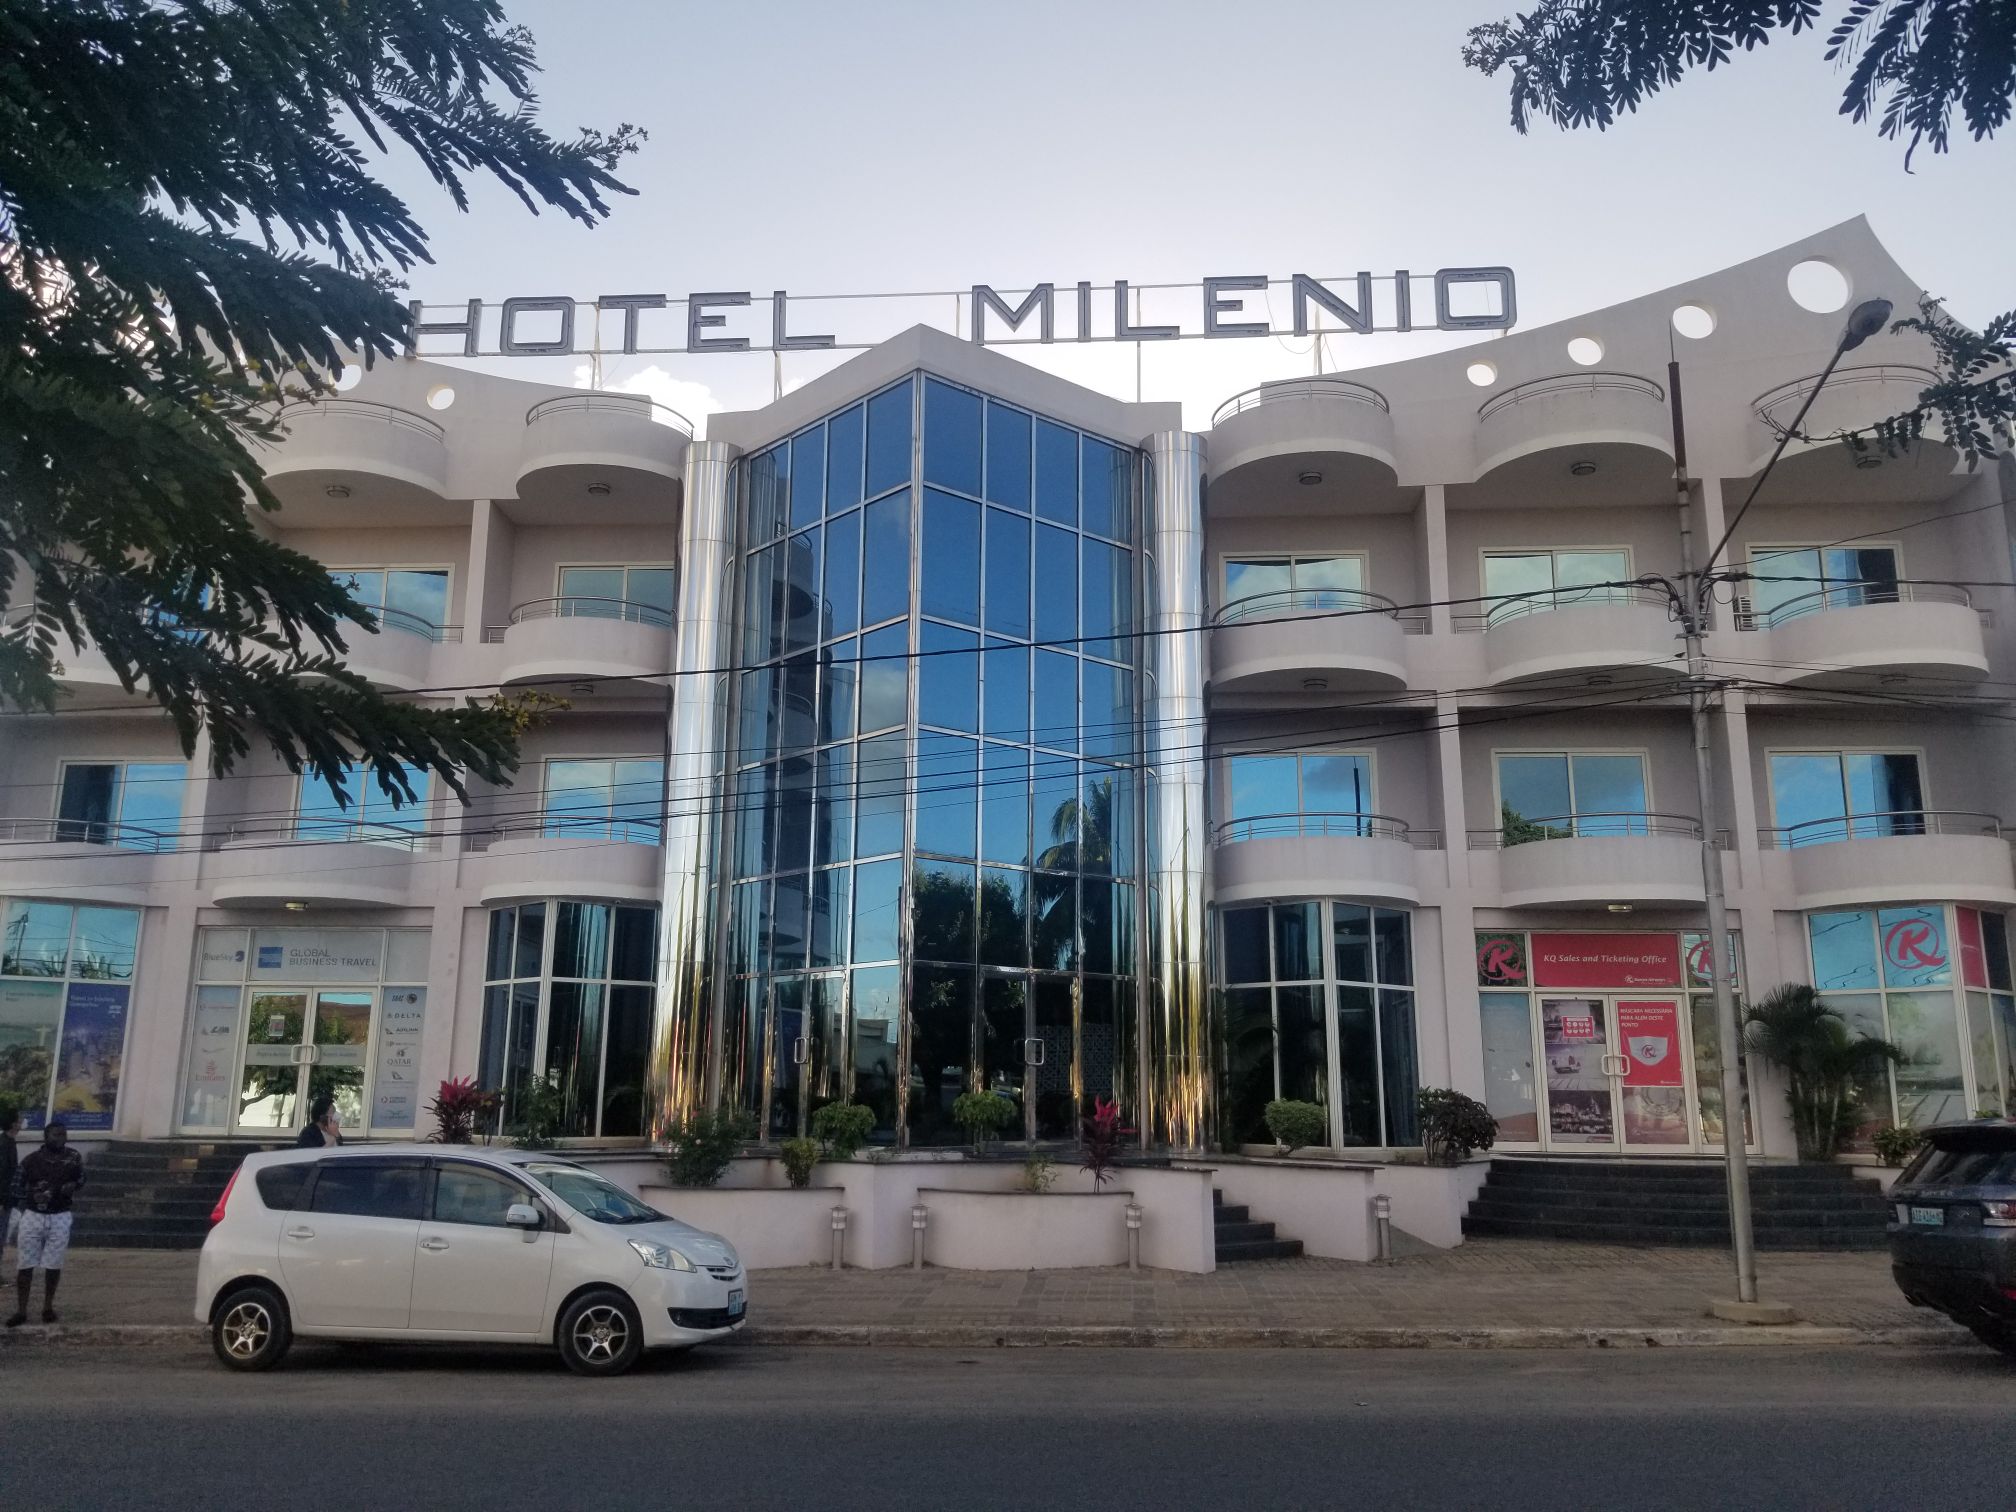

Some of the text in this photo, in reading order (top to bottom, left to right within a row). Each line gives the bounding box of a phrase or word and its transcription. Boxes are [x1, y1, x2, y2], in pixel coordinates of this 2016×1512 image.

[404, 266, 1517, 358] HOTEL MILENIO
[290, 949, 330, 958] GLOBAL
[289, 958, 377, 967] BUSINESS TRAVEL
[1558, 954, 1580, 962] Sales
[1582, 954, 1599, 962] and
[1601, 955, 1639, 964] Ticketing
[1641, 955, 1667, 965] Office
